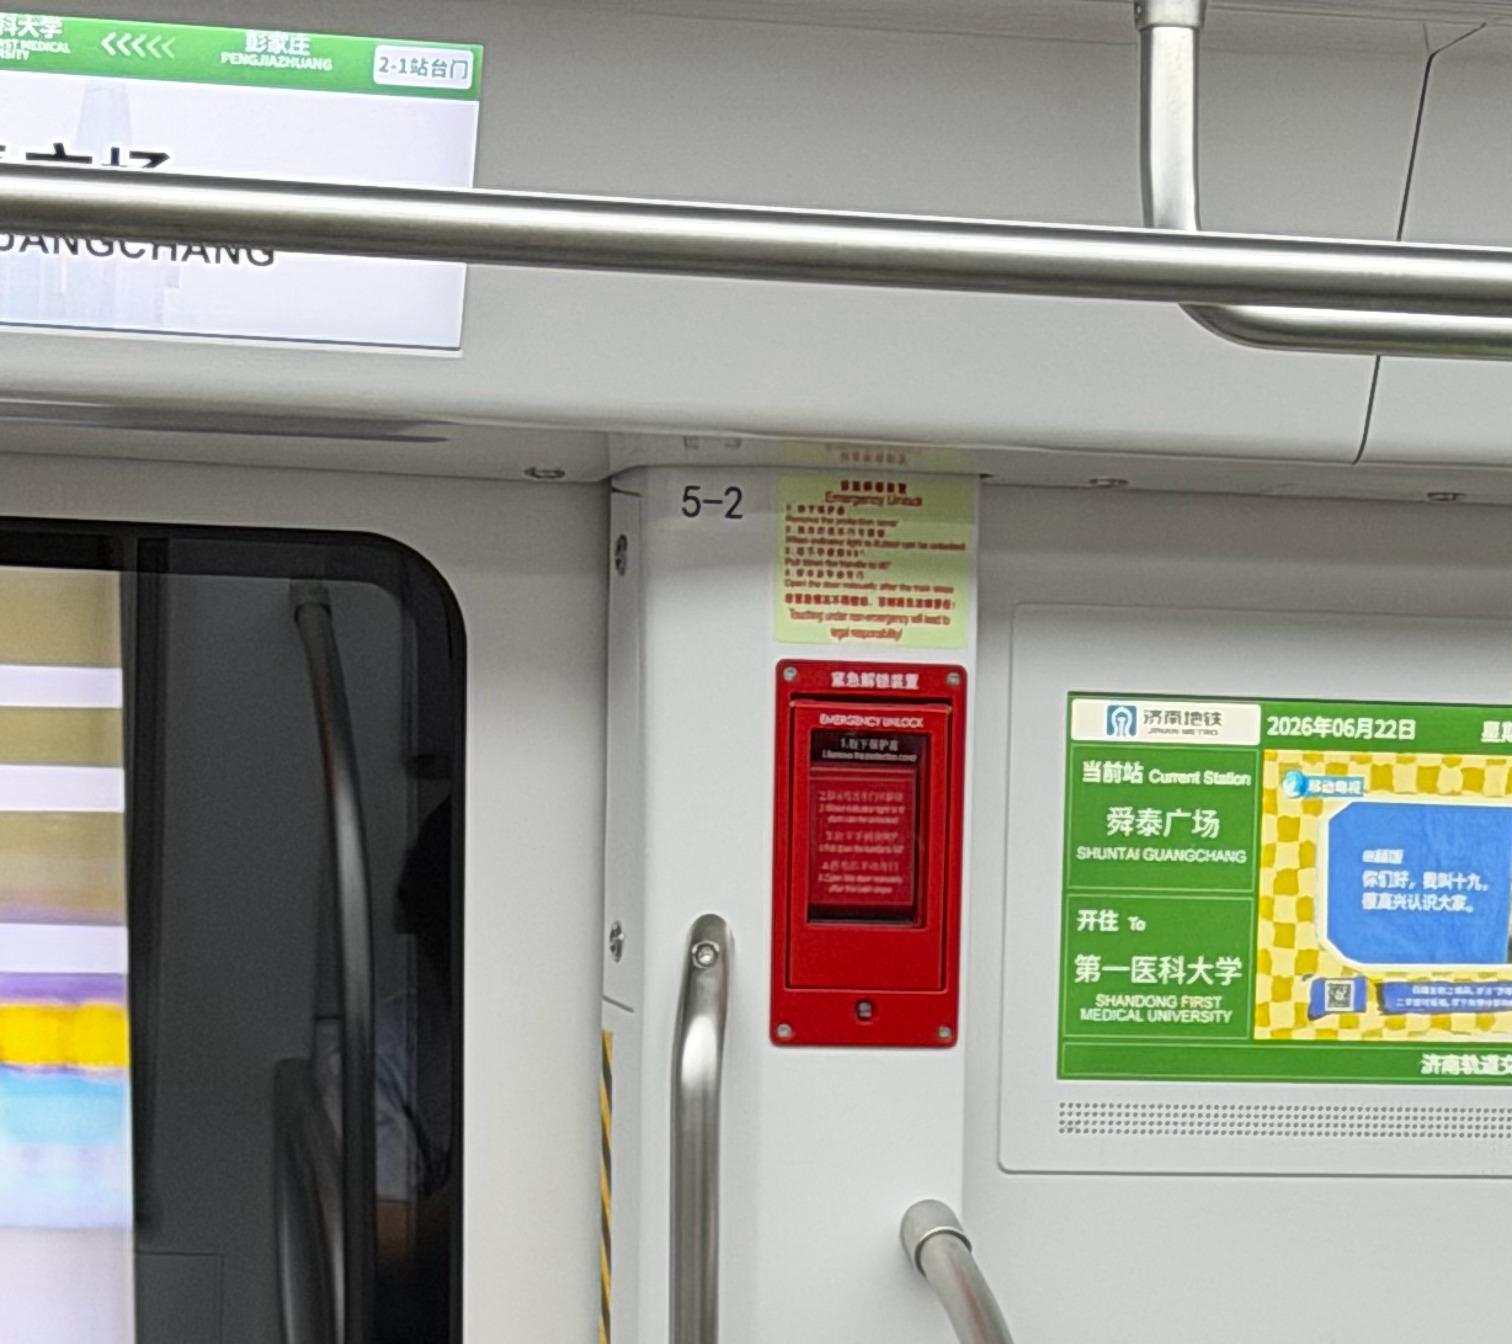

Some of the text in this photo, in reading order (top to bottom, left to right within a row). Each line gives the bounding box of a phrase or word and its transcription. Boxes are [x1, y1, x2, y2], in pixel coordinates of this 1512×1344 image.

[245, 30, 311, 56] 彭家庄
[221, 51, 333, 72] PENGJIAZHUANG
[378, 56, 469, 80] 2-1站台门
[681, 486, 743, 519] 5-2
[1143, 709, 1222, 727] 济南地铁
[1266, 715, 1416, 741] 2026年06月22日
[1082, 760, 1252, 786] 当前站 Current Station
[1106, 806, 1221, 839] 舜泰广场
[1076, 846, 1248, 864] SHUNTAI GUANGCHANG
[1077, 909, 1147, 932] 开往 To
[1074, 954, 1243, 986] 第一医科大学
[1095, 993, 1223, 1009] SHANDONG FIRST
[1080, 1008, 1233, 1024] MEDICAL UNIVERSITY
